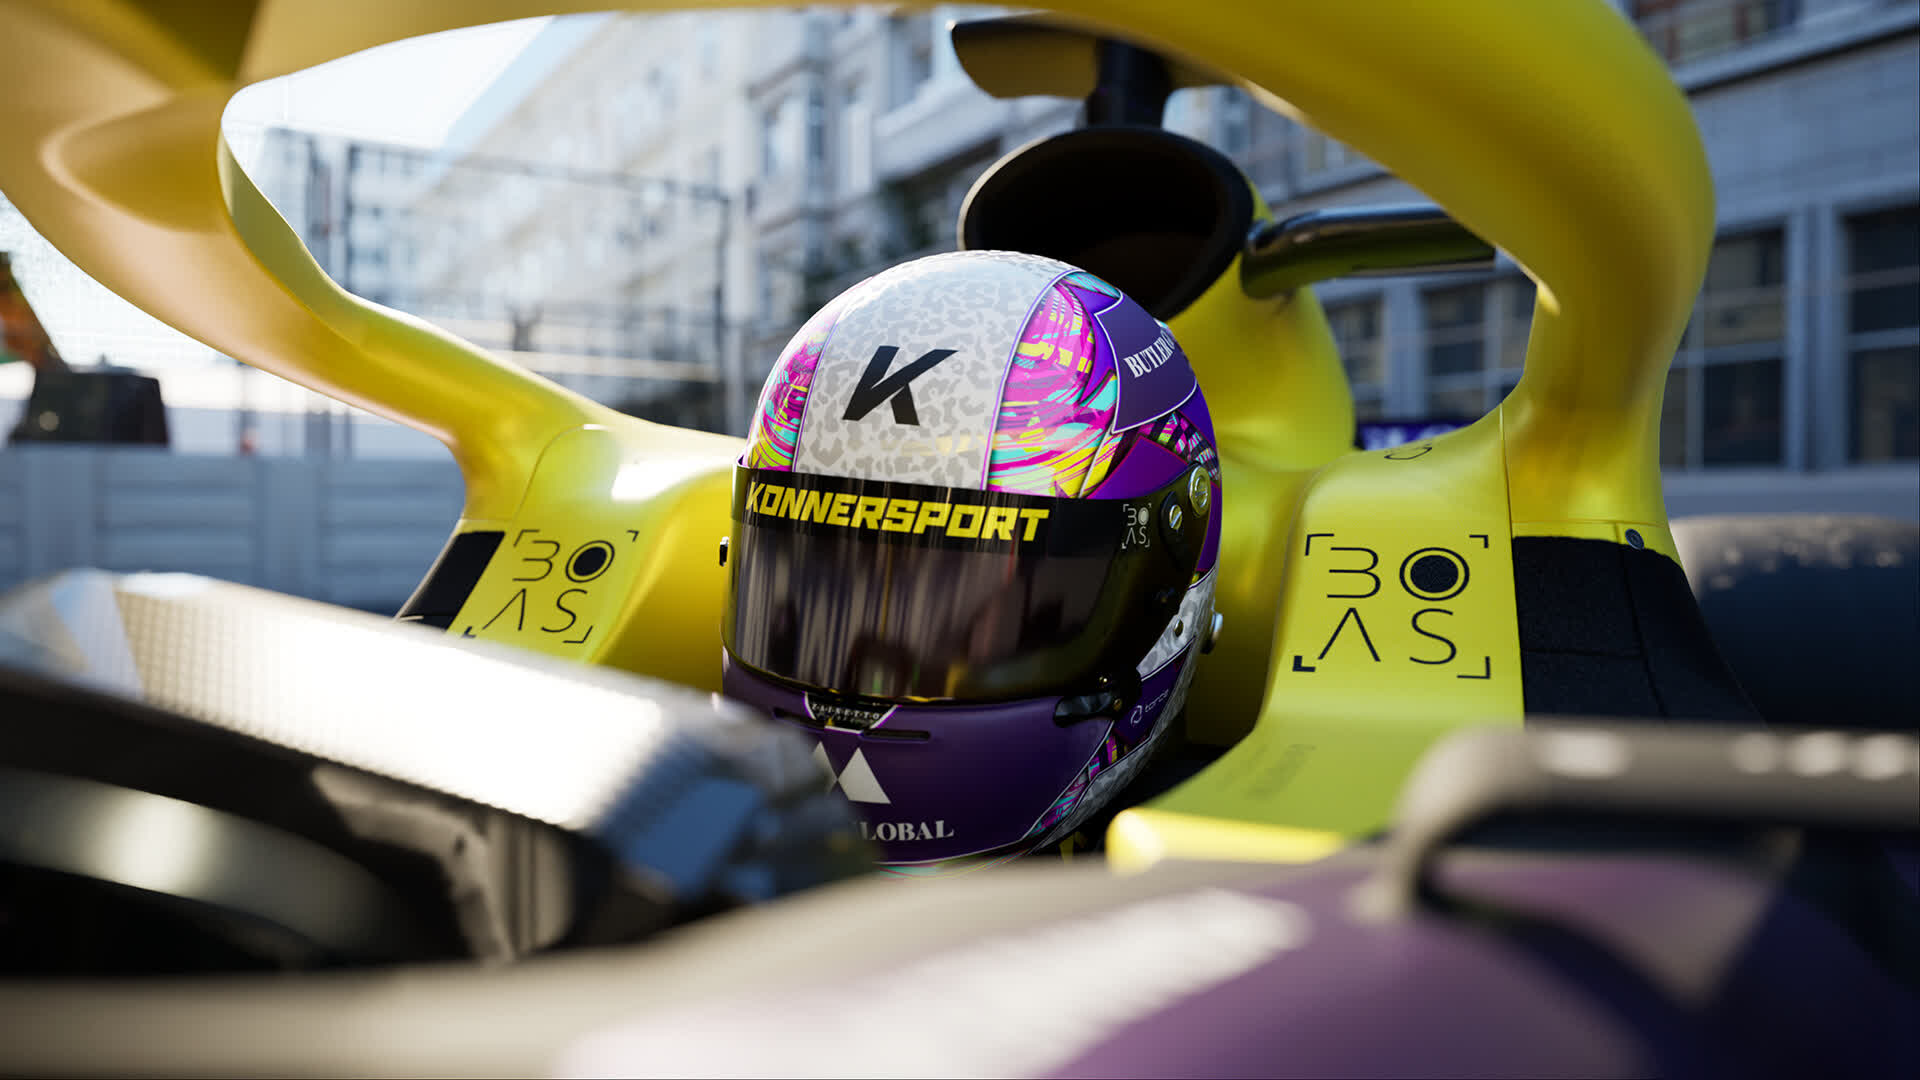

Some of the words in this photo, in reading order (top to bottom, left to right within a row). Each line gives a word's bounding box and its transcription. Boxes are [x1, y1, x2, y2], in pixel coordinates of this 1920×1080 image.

[1123, 336, 1174, 378] BUTLER
[842, 345, 959, 426] K
[745, 481, 1050, 541] KONNERSPORT
[856, 819, 955, 841] LOBAL
